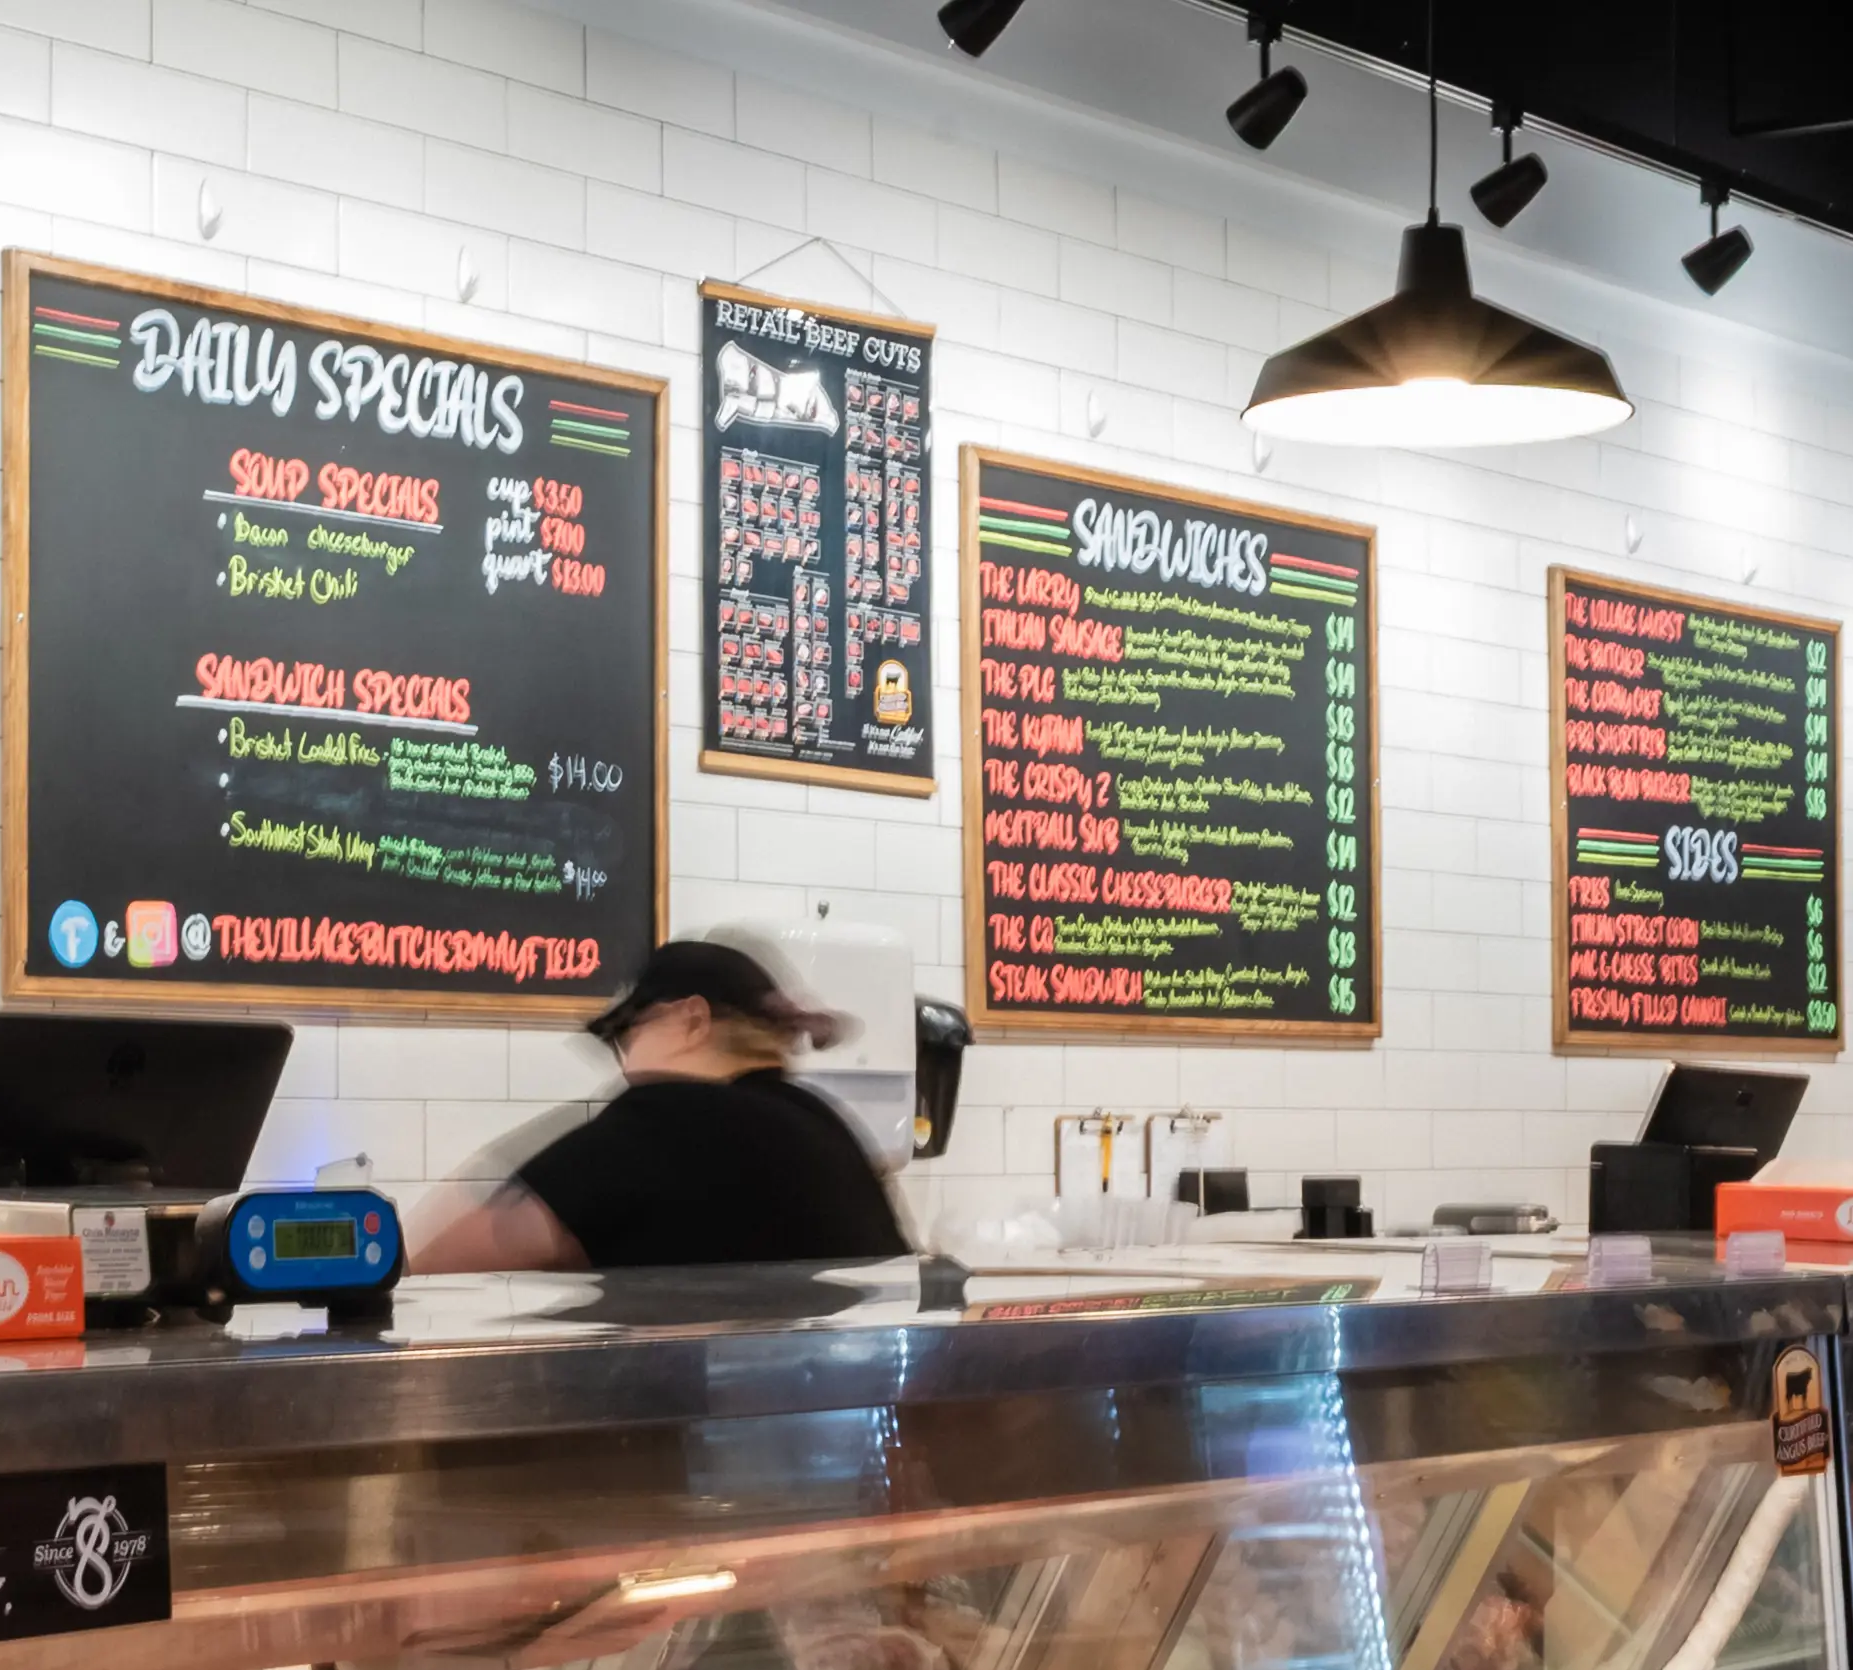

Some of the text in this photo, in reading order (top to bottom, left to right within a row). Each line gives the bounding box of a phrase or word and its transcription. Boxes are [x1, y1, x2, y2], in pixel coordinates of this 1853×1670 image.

[716, 300, 921, 372] RETAIL BEEF CUTS
[128, 309, 524, 454] DAILY SPECIALS
[230, 448, 440, 524] SOUP SPECIALS
[487, 477, 532, 518] cup
[484, 507, 541, 552] pint
[1073, 498, 1267, 596] SANDWICHES
[229, 555, 358, 604] Brisket Chili
[482, 548, 552, 595] quart
[980, 561, 1014, 603] THE
[1016, 567, 1080, 617] LARRY
[982, 609, 1046, 650] ITALIAN
[1049, 614, 1124, 663] SAUSAGE
[195, 653, 471, 724] SANDWICH SPECIALS
[230, 717, 291, 761] Brisket
[549, 752, 623, 792] $14.00
[983, 759, 1020, 799] THE
[986, 810, 1078, 850] MEATBALL
[1664, 825, 1738, 884] SIDES
[987, 860, 1025, 900] THE
[1029, 863, 1098, 904] CLASSIC
[1102, 868, 1232, 914] CHEESEBURGER
[1569, 876, 1610, 909] FRIES
[989, 914, 1026, 953] THE
[989, 960, 1049, 1004] STEAK
[1050, 964, 1143, 1006] SANDWICH
[1777, 1438, 1806, 1459] ANGUS
[34, 1535, 147, 1565] Since 1978
